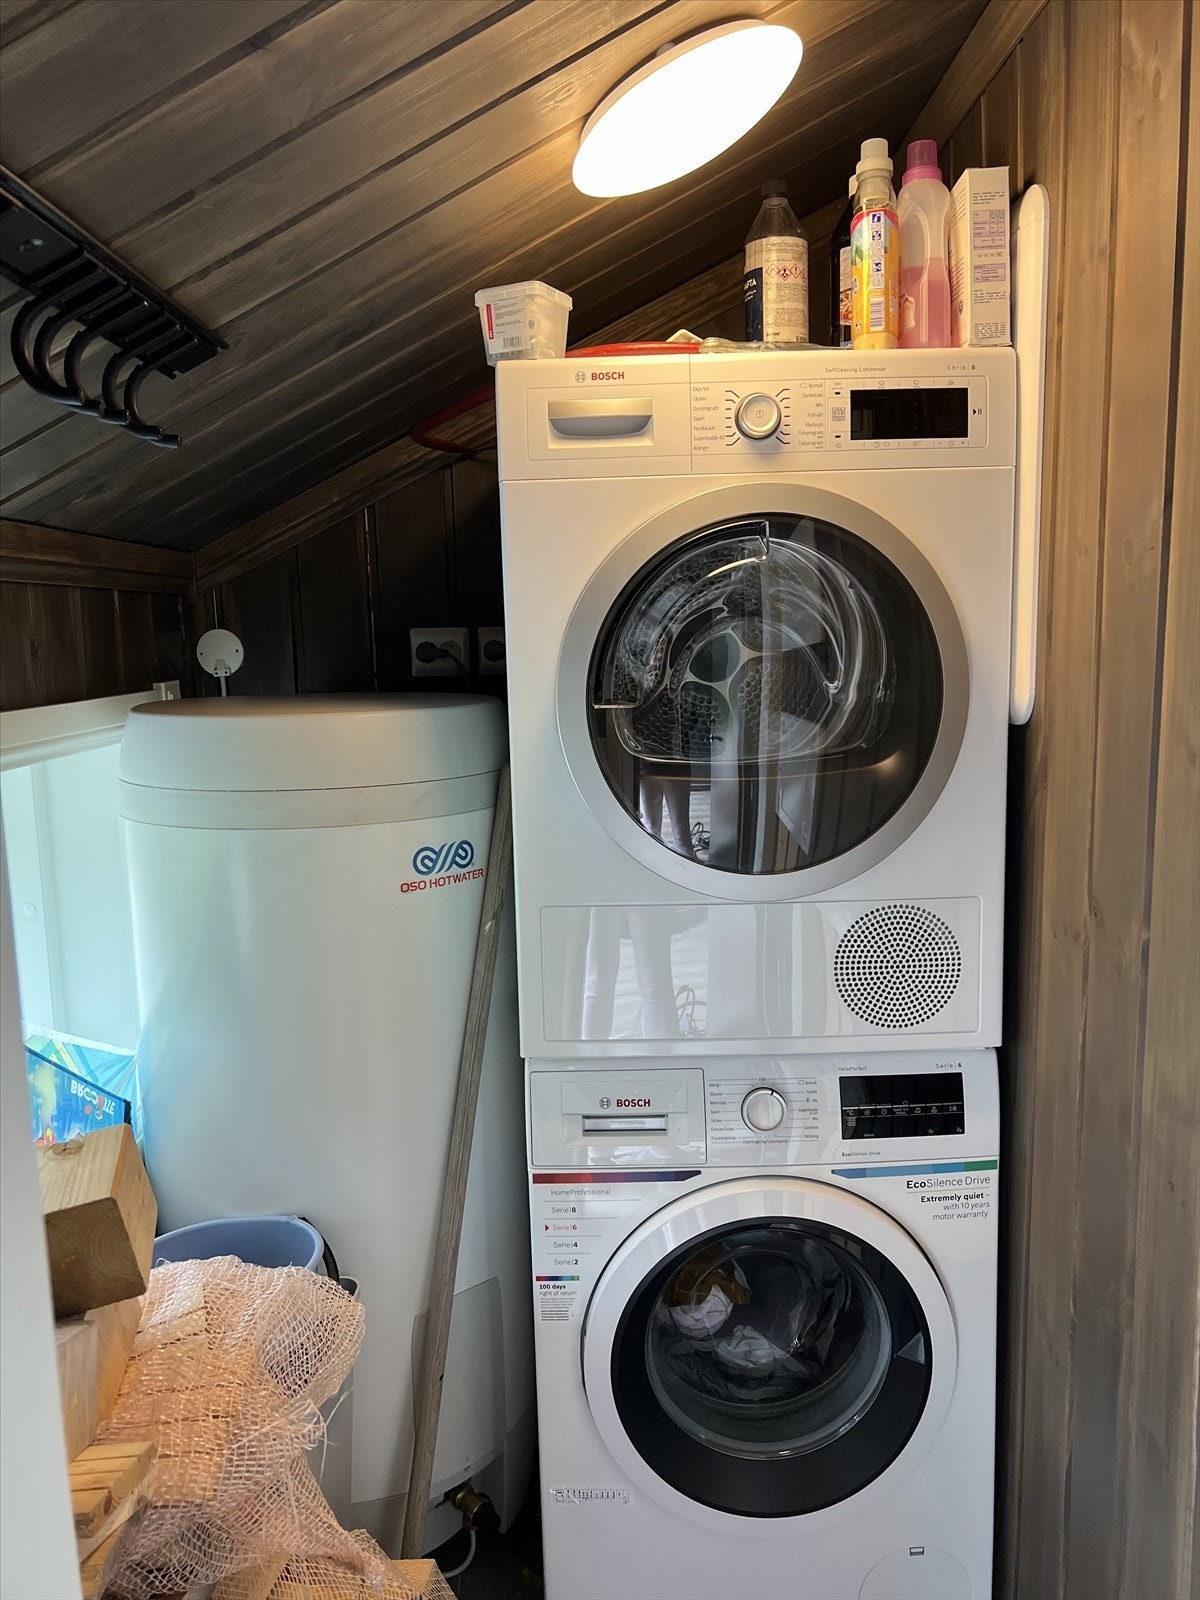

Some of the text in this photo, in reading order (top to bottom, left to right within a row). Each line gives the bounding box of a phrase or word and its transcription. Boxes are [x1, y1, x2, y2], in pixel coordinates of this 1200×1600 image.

[591, 371, 625, 381] BOSCH
[400, 868, 484, 892] OSO HOTWATER
[616, 1098, 651, 1107] BOSCH
[906, 1176, 991, 1189] EcoSilence Drive
[921, 1194, 961, 1202] Extremely
[964, 1192, 984, 1201] quiet
[971, 1202, 990, 1210] years
